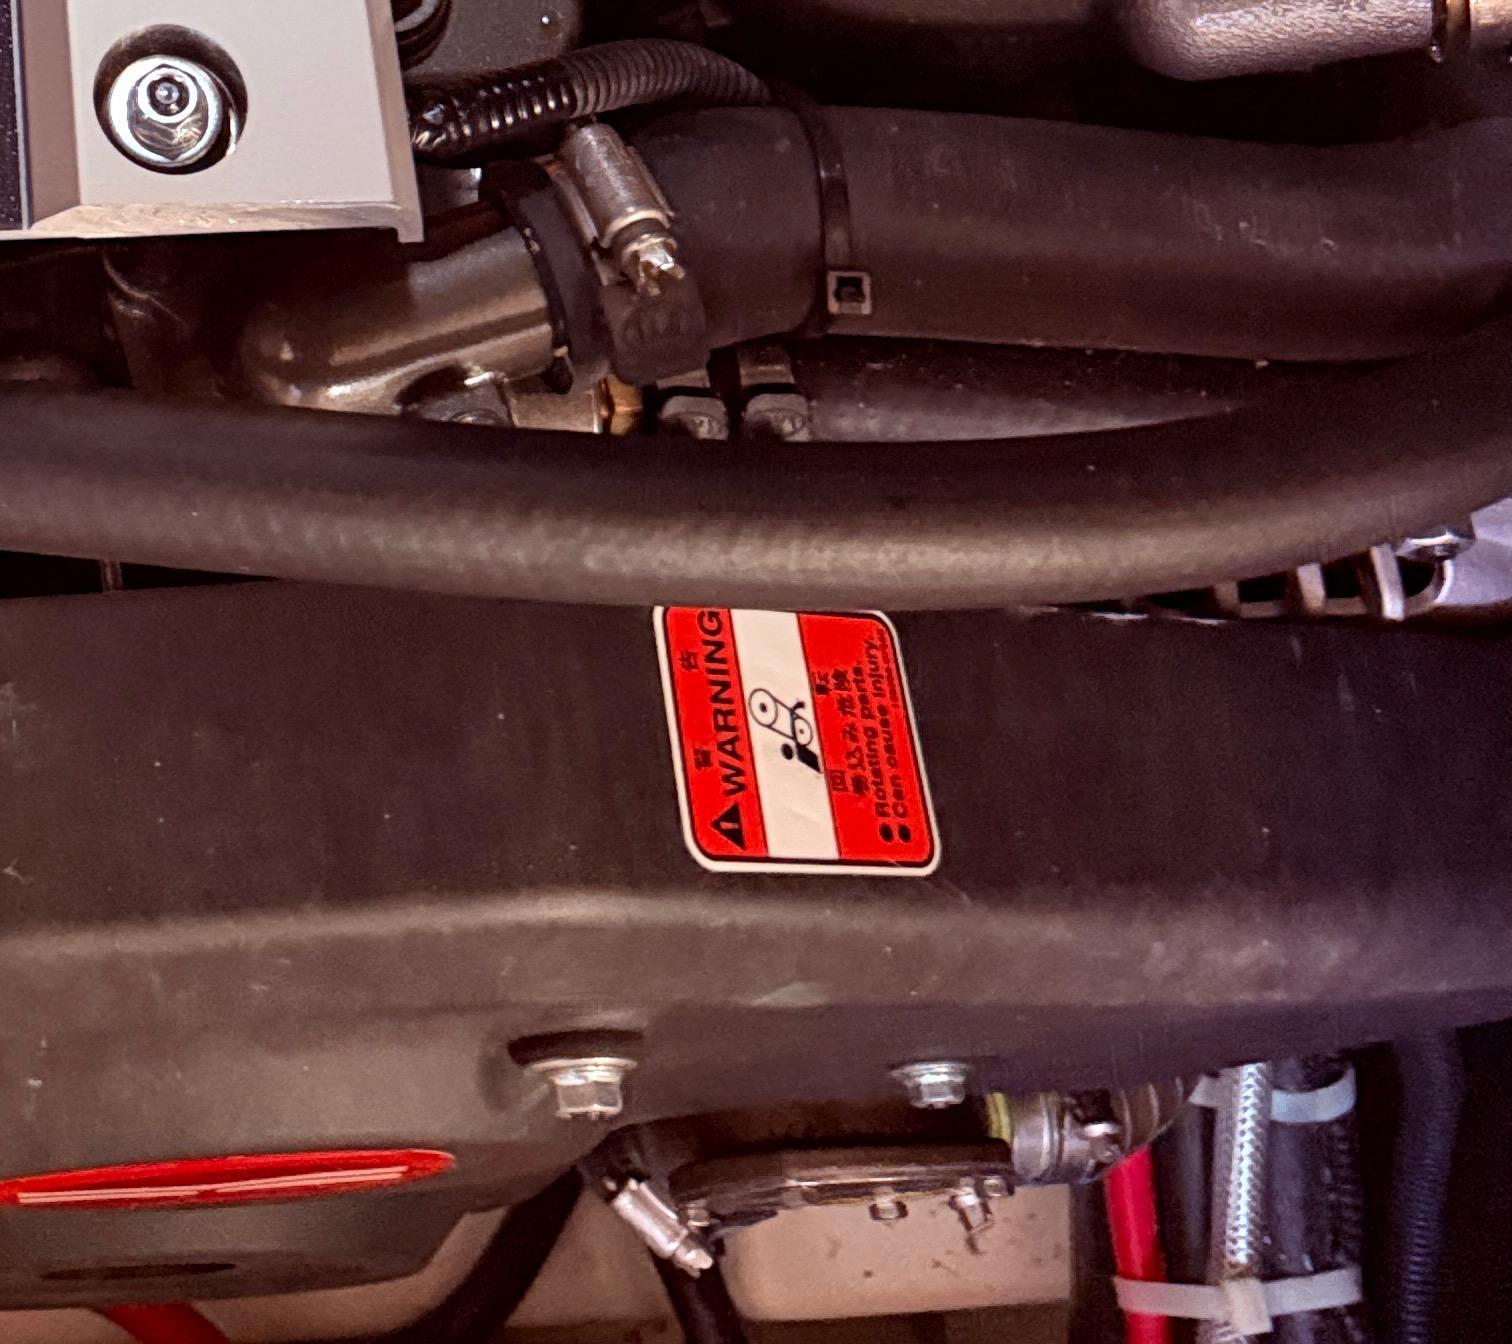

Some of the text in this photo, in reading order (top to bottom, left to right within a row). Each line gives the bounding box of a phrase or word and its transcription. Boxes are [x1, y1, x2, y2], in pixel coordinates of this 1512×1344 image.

[694, 609, 748, 797] WARNING
[875, 703, 899, 768] cause
[863, 725, 891, 817] Rotating
[887, 774, 908, 818] Can
